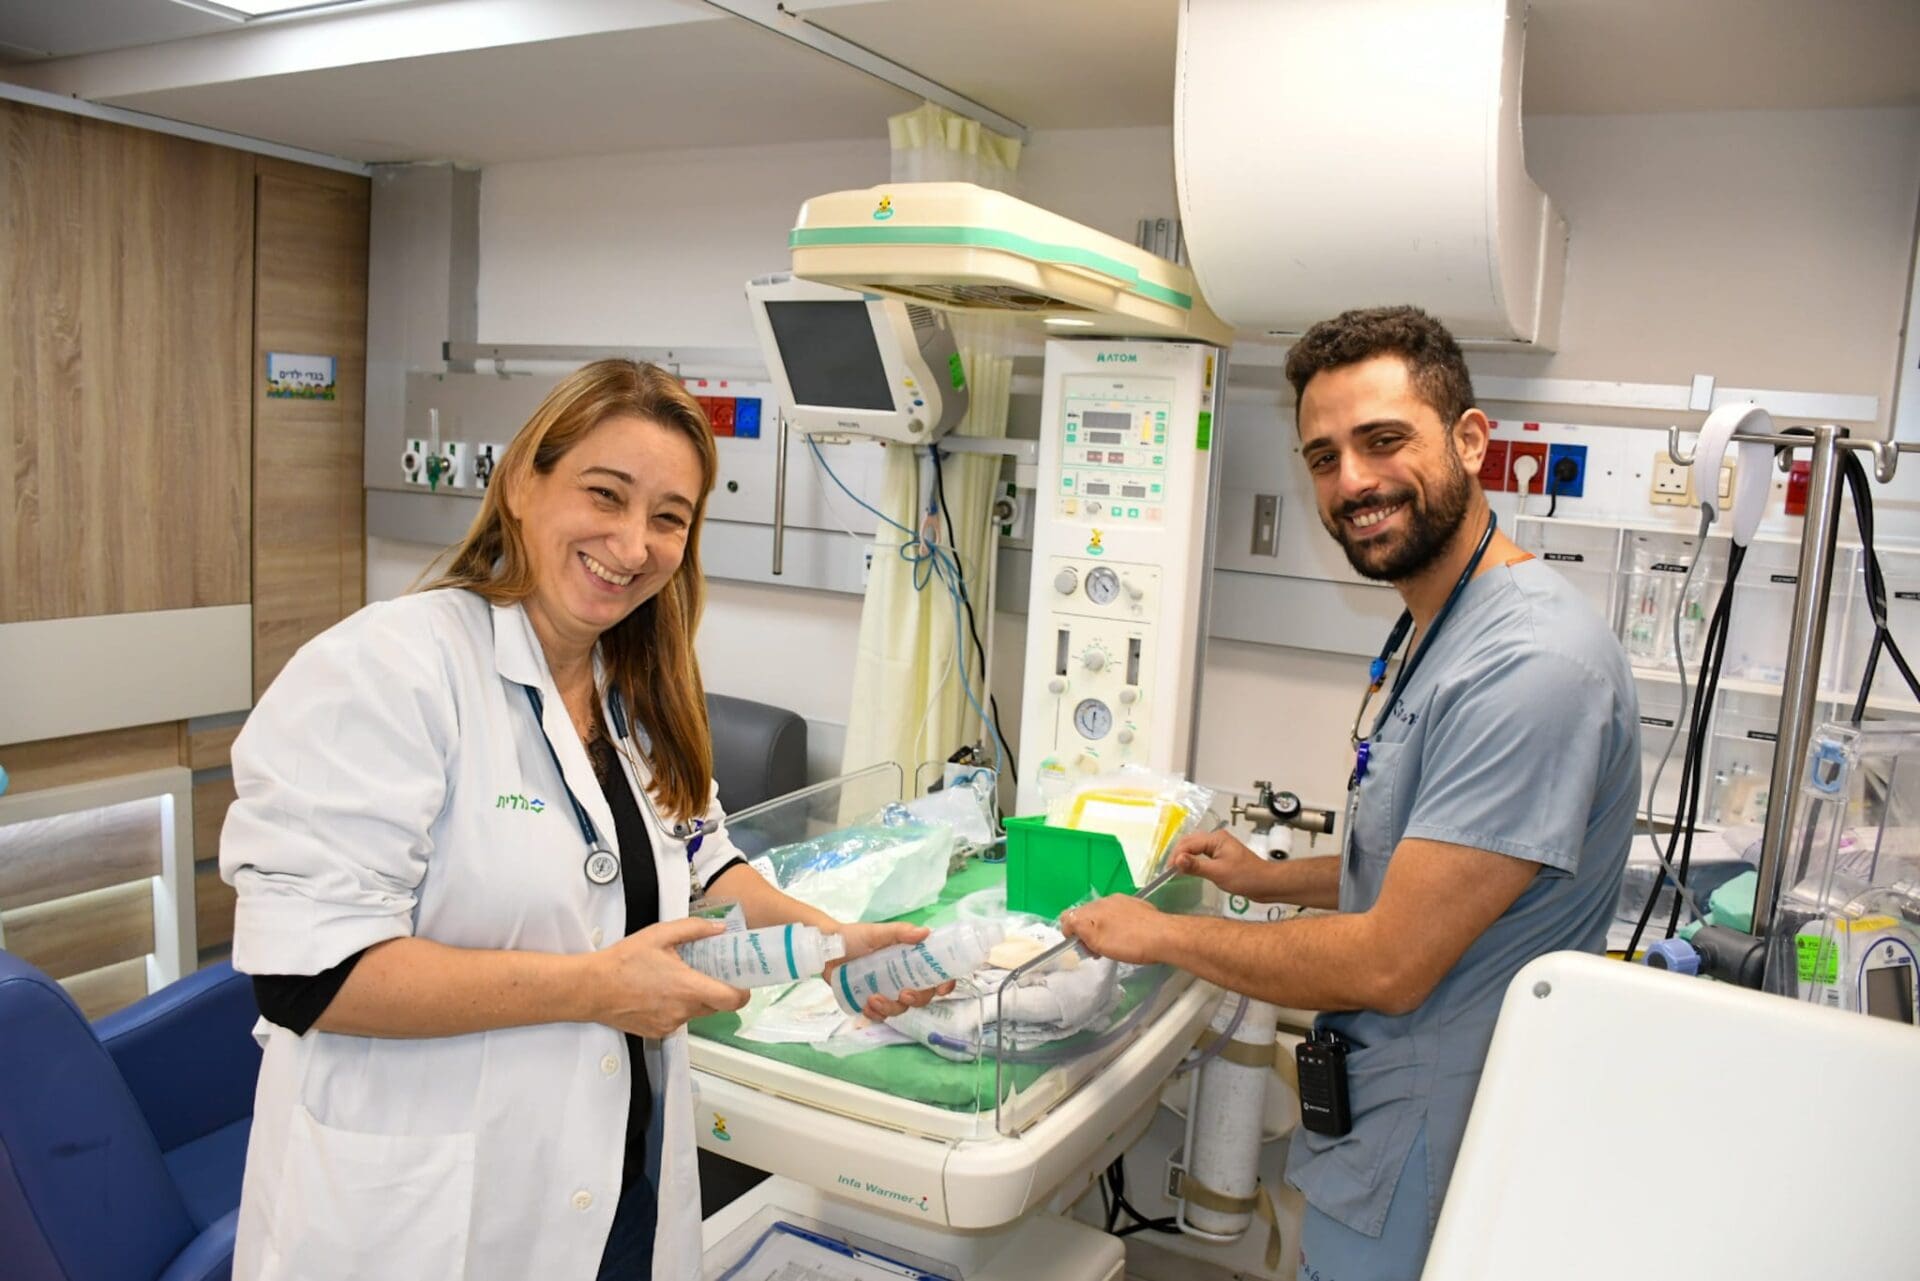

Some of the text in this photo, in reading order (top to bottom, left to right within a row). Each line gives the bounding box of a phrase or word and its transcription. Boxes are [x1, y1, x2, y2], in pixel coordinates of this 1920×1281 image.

[1107, 354, 1137, 362] ATOM
[280, 369, 324, 381] בגדי ילדים
[838, 1174, 861, 1189] Infa
[865, 1182, 915, 1204] Warmer
